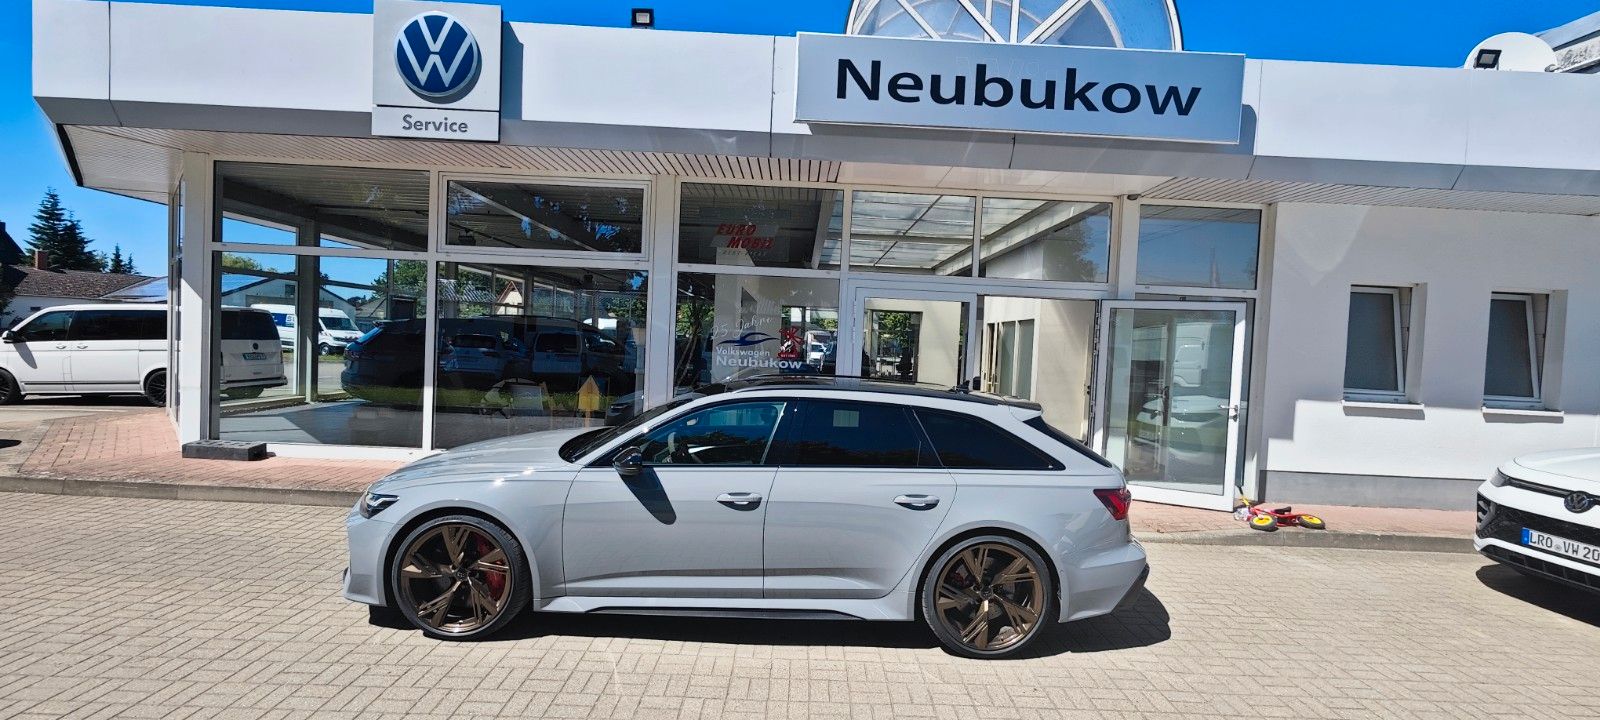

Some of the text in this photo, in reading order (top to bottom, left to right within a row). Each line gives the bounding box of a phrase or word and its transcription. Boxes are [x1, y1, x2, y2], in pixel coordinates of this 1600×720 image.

[396, 13, 477, 95] VW
[836, 58, 1202, 117] Neubukow
[402, 114, 468, 132] Service
[717, 223, 757, 236] EURO
[734, 314, 772, 338] Jahre
[716, 346, 770, 358] Volkswagen
[716, 356, 803, 370] Neubukow
[1530, 532, 1553, 548] LRO
[1563, 541, 1581, 556] VW
